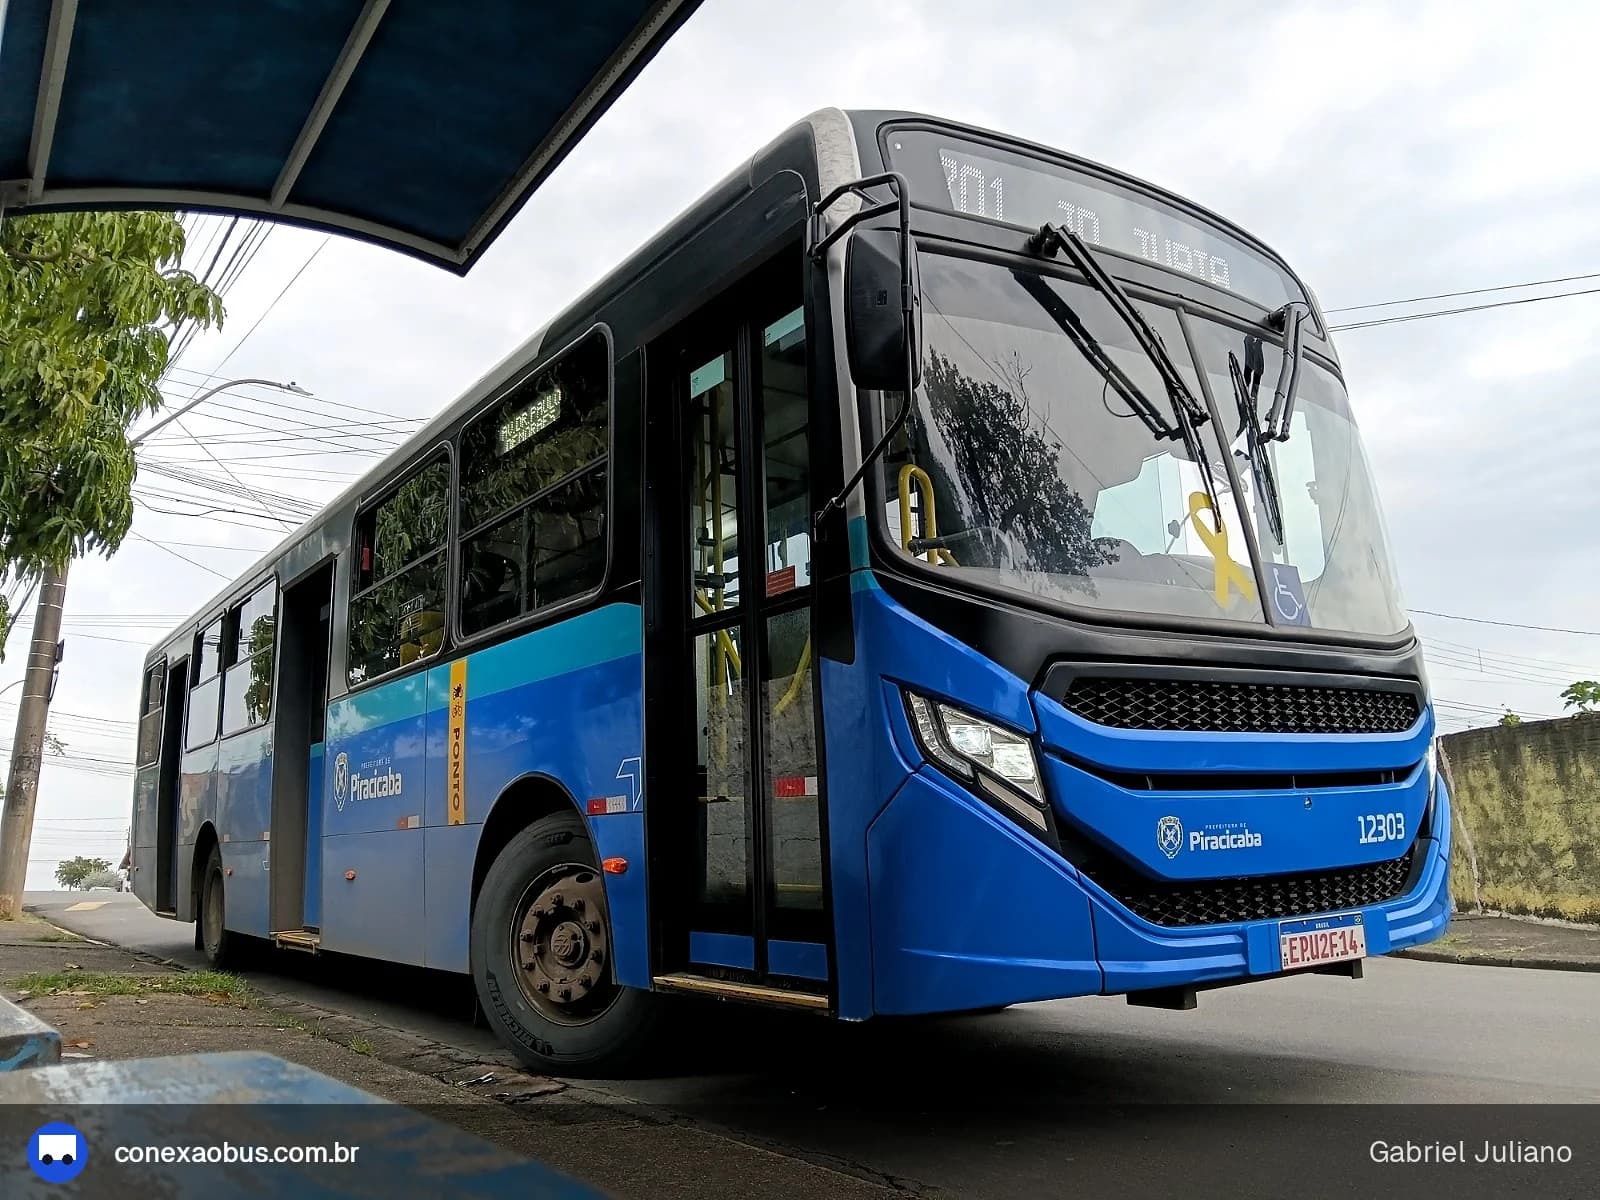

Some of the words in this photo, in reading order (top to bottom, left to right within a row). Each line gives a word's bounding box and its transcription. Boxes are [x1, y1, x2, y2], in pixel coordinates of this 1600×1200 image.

[350, 767, 402, 802] Piracicaba
[451, 727, 460, 811] PONTO
[1189, 829, 1262, 851] Piracicaba
[1357, 812, 1405, 844] 12303
[1288, 928, 1358, 964] EPU2F14
